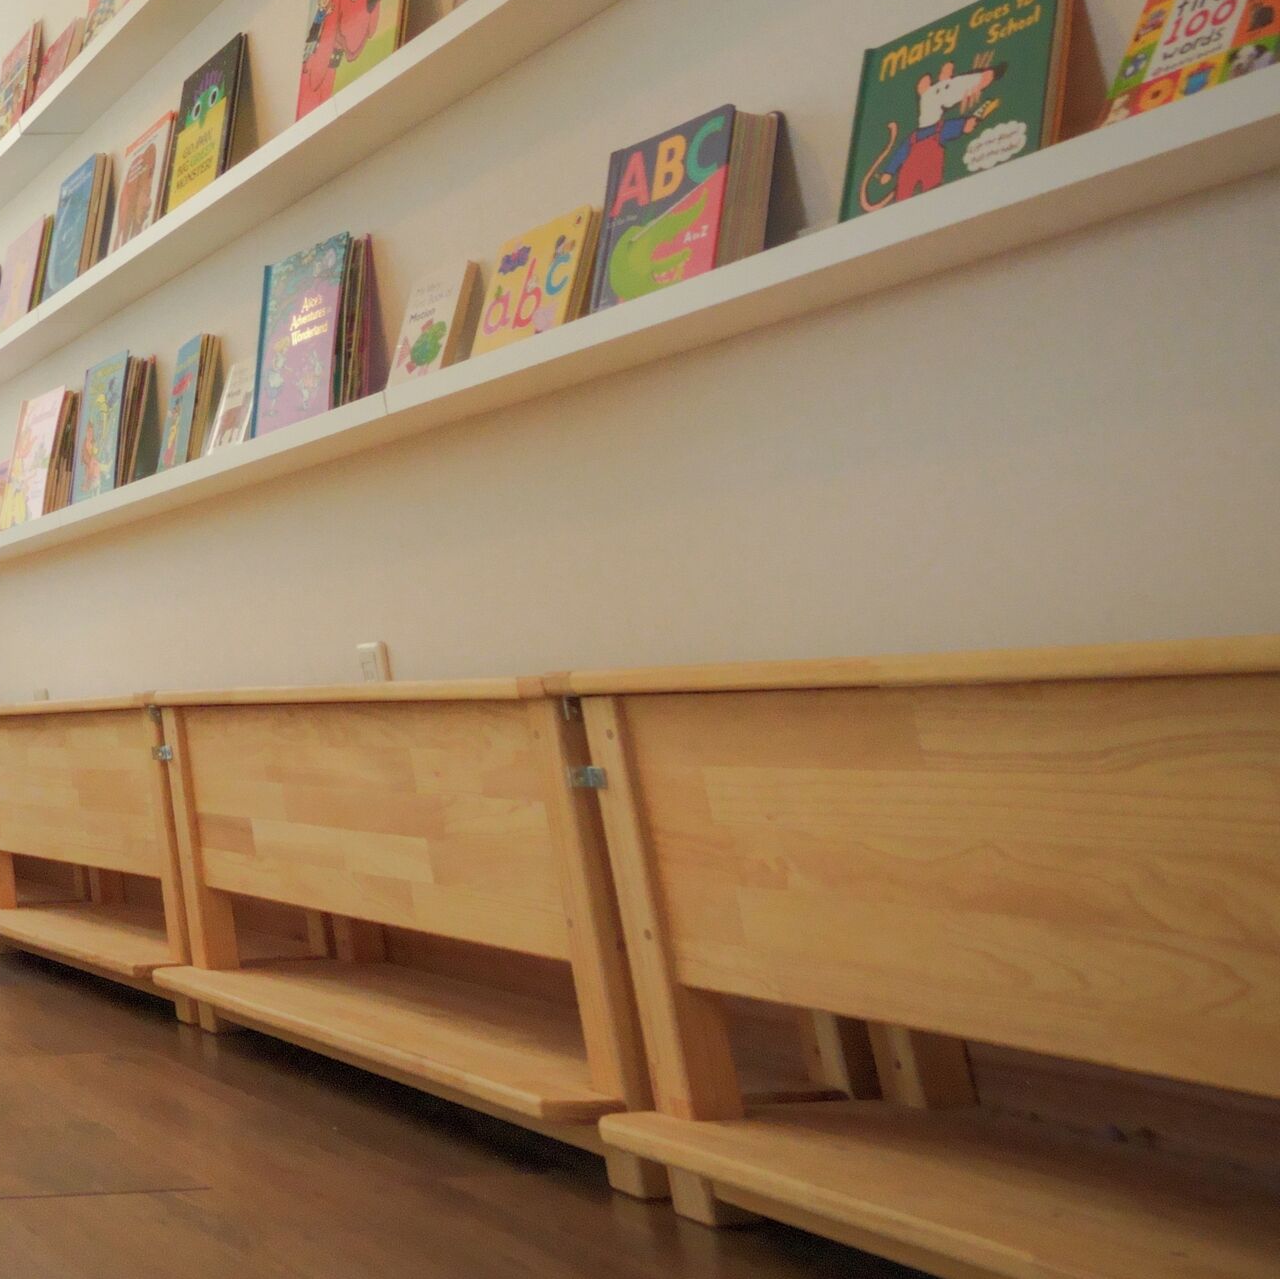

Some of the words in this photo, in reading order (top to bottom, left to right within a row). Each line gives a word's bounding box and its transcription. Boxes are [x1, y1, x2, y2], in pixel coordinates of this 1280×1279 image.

[879, 24, 960, 82] Maisy
[969, 2, 1011, 29] Goes
[986, 4, 1042, 44] School
[1163, 26, 1227, 60] words
[612, 115, 725, 218] ABC
[482, 250, 571, 336] abc
